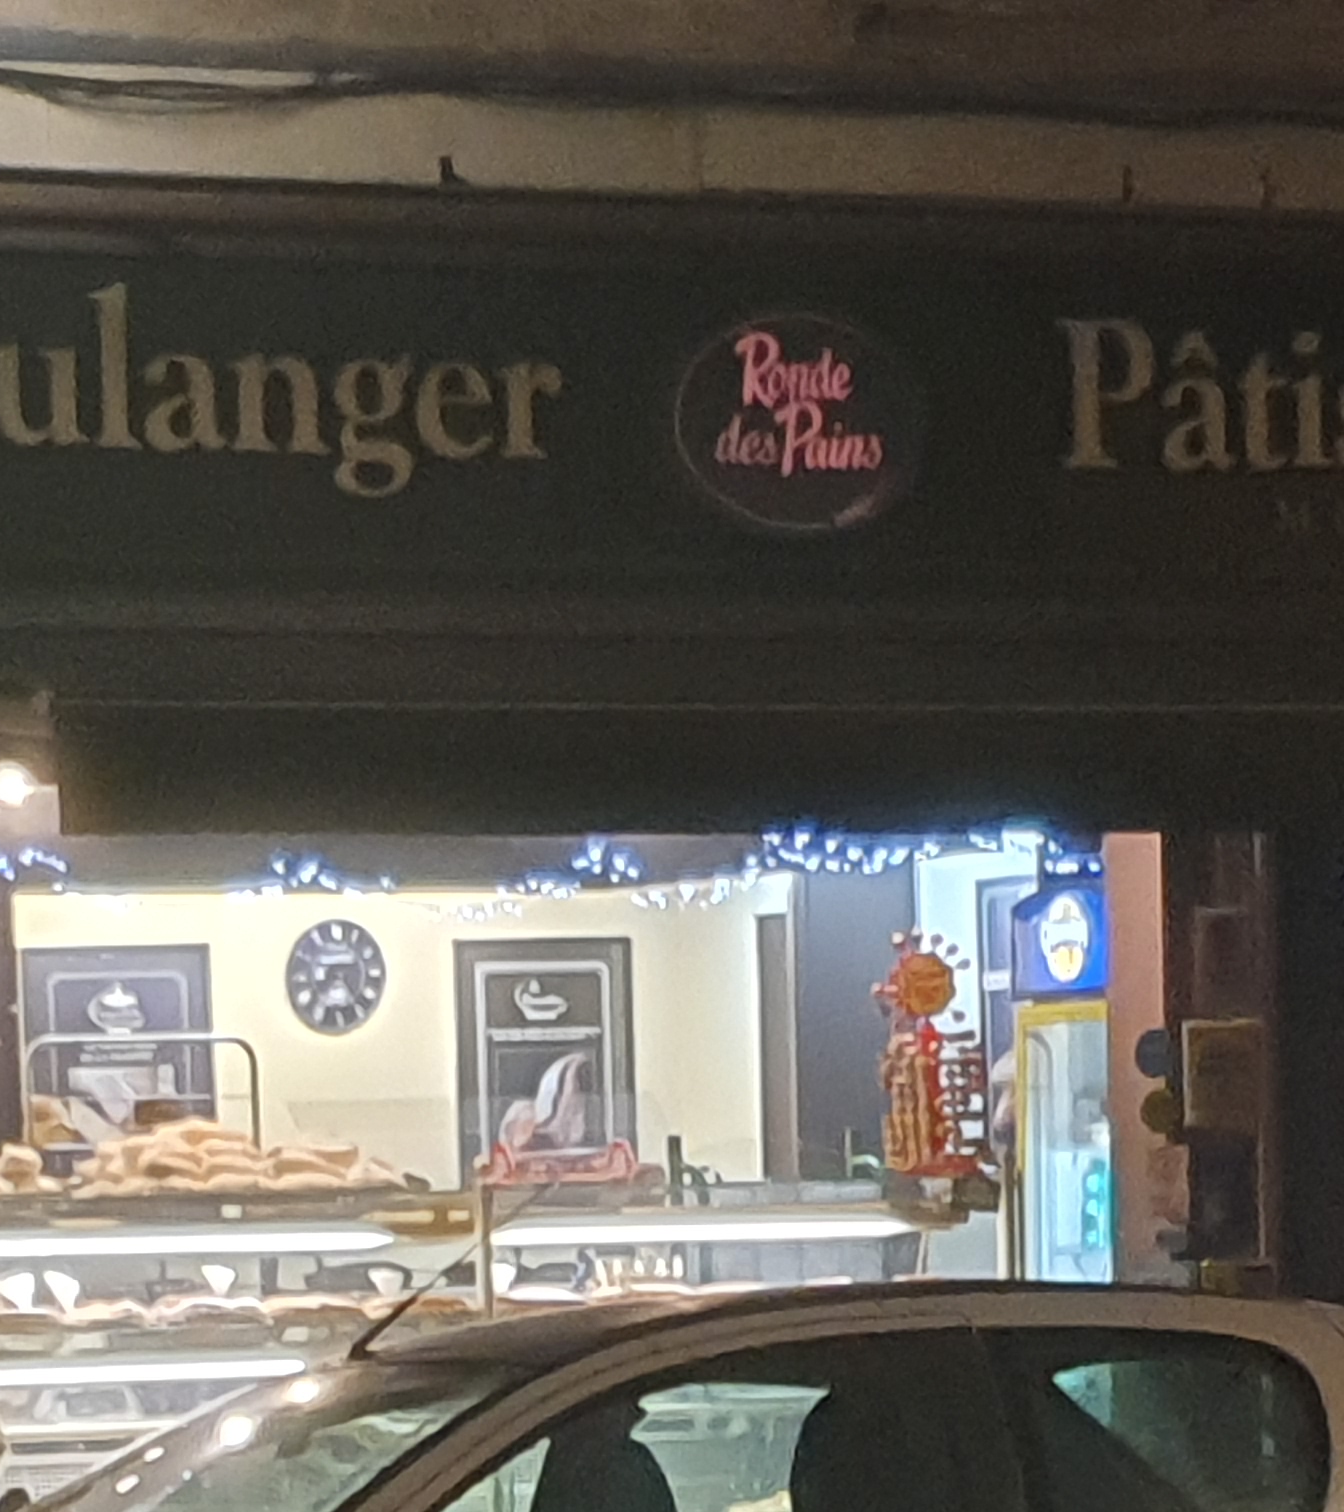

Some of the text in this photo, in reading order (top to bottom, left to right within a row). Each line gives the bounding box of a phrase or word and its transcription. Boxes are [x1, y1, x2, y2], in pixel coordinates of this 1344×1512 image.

[734, 330, 854, 408] Ronde
[714, 398, 884, 478] des Pains
